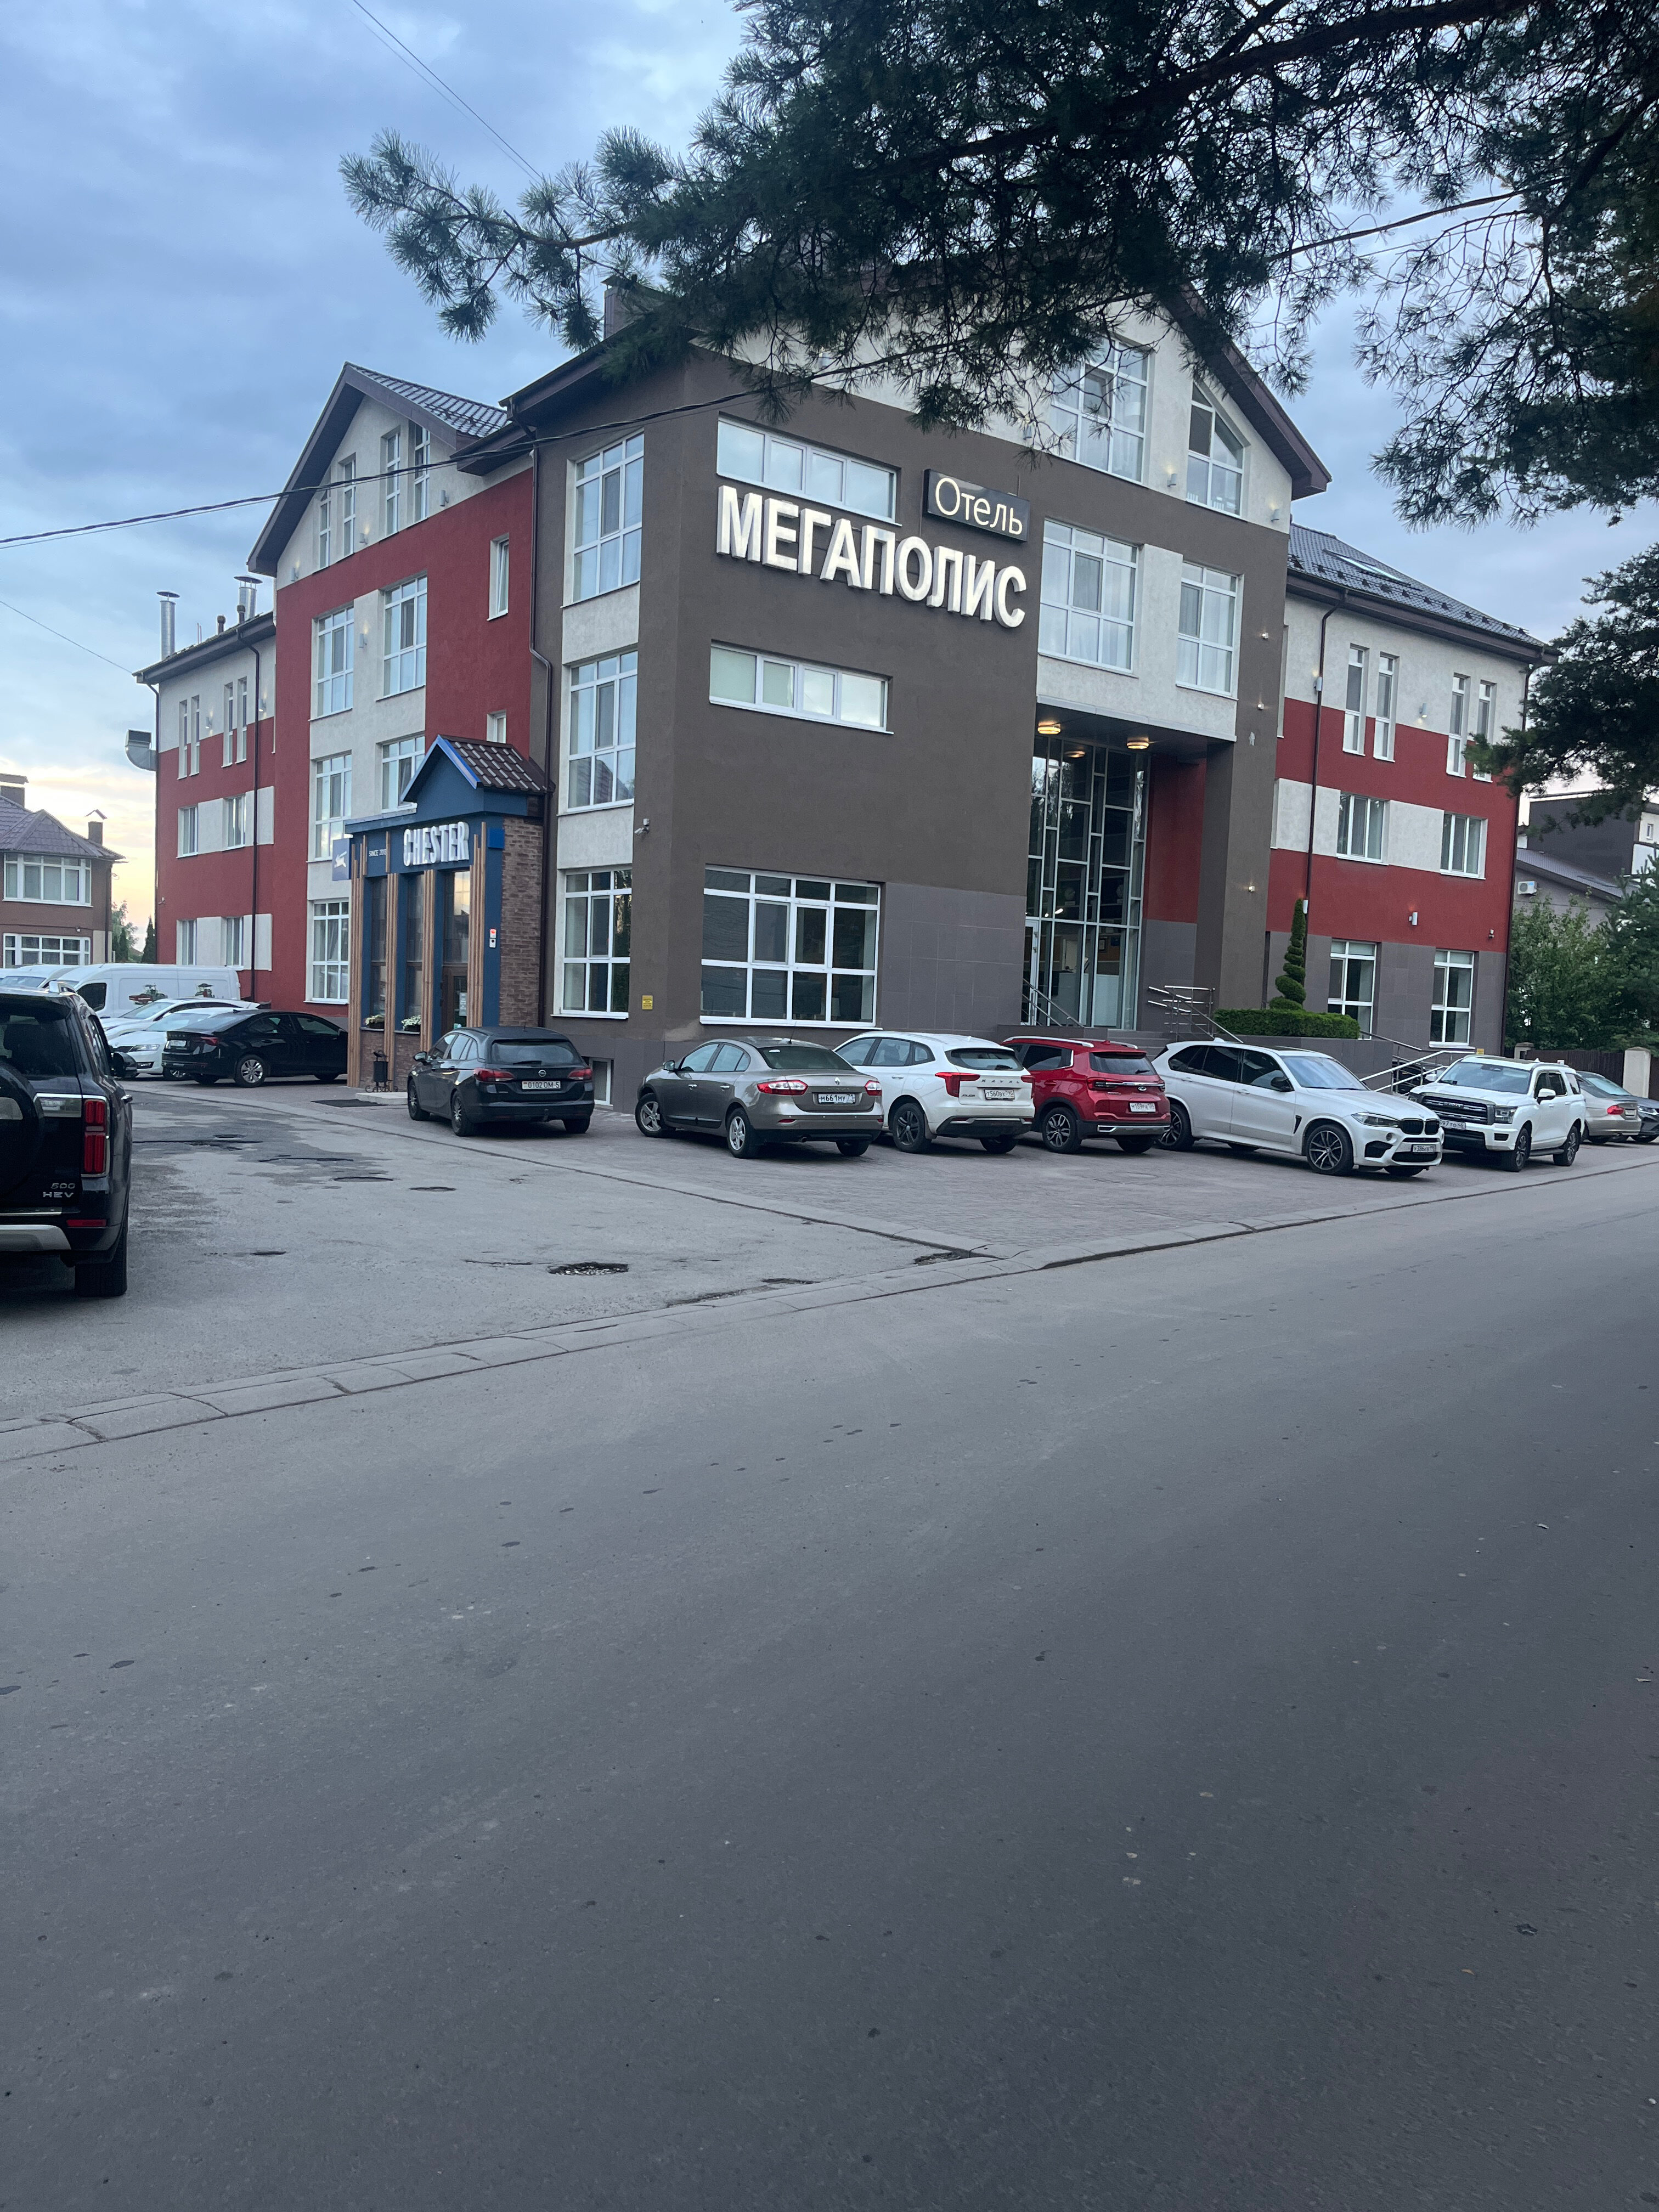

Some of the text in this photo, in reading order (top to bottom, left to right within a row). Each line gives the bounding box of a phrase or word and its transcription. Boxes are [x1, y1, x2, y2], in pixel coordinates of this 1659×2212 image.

[935, 477, 1023, 535] Отель
[716, 485, 1026, 628] МЕГАПОЛИС
[403, 821, 470, 866] CHESTER
